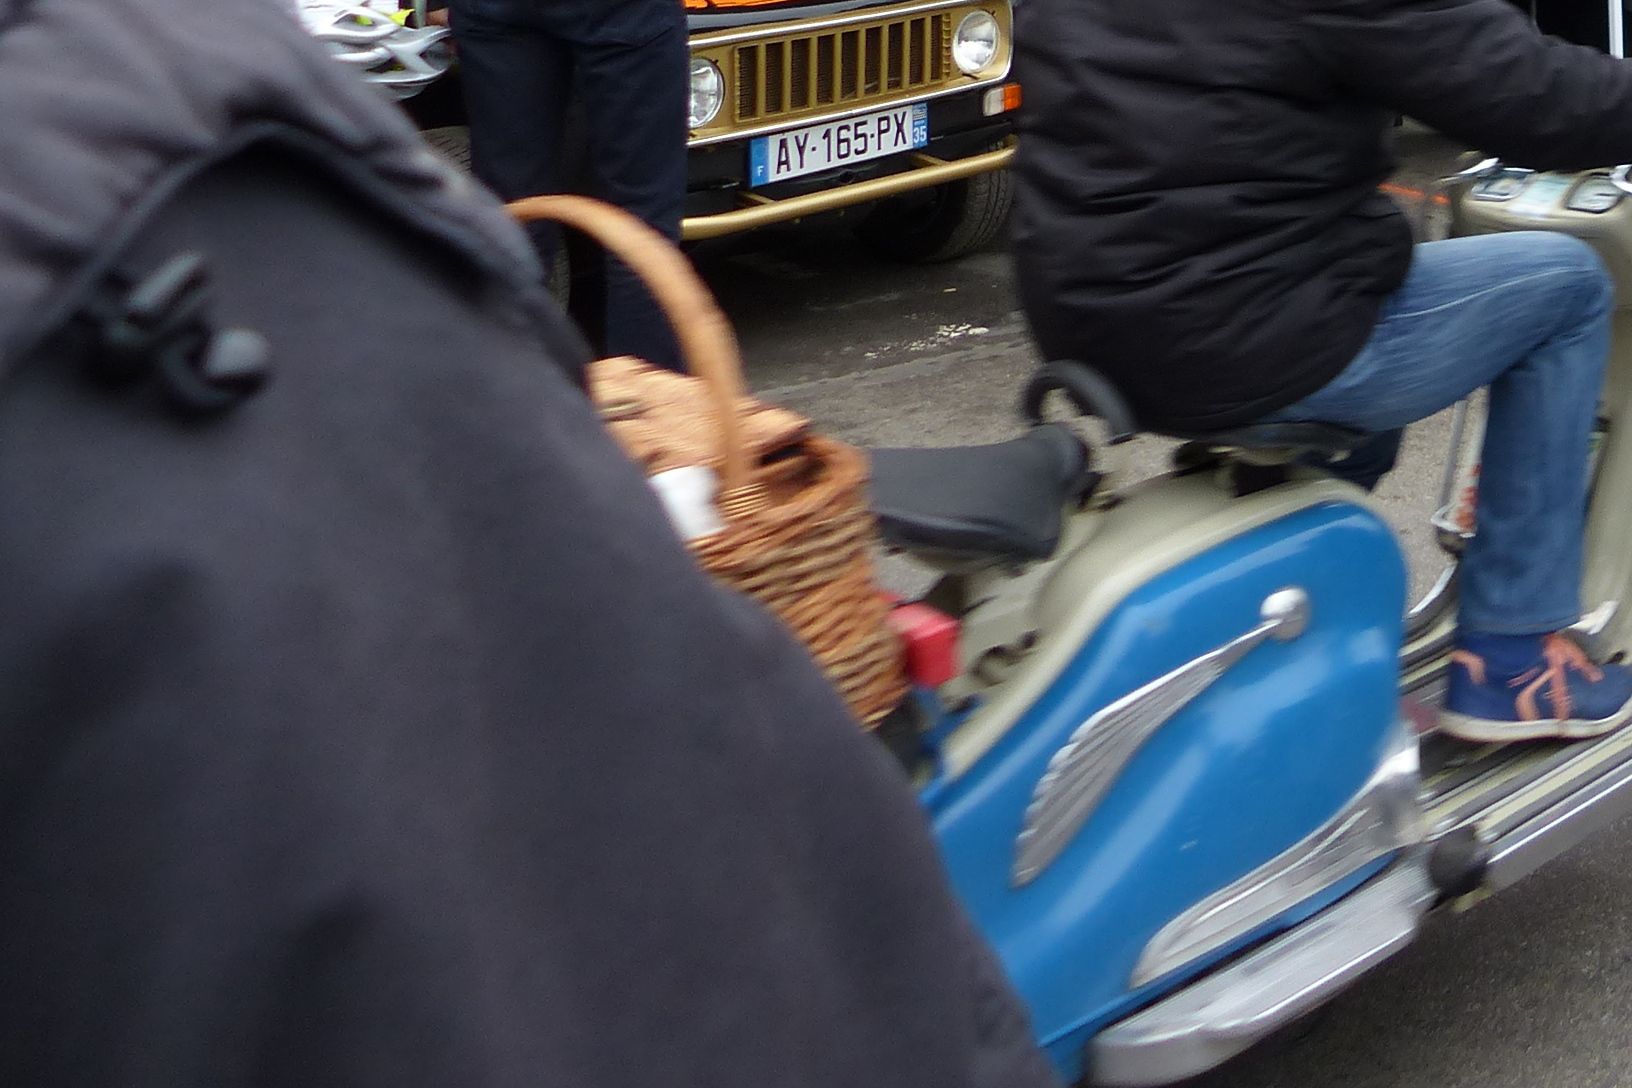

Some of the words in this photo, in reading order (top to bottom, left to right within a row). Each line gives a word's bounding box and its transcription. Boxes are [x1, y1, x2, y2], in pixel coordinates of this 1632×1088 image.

[776, 111, 908, 175] AY-165-PX
[913, 125, 928, 144] 35
[756, 164, 765, 177] F
